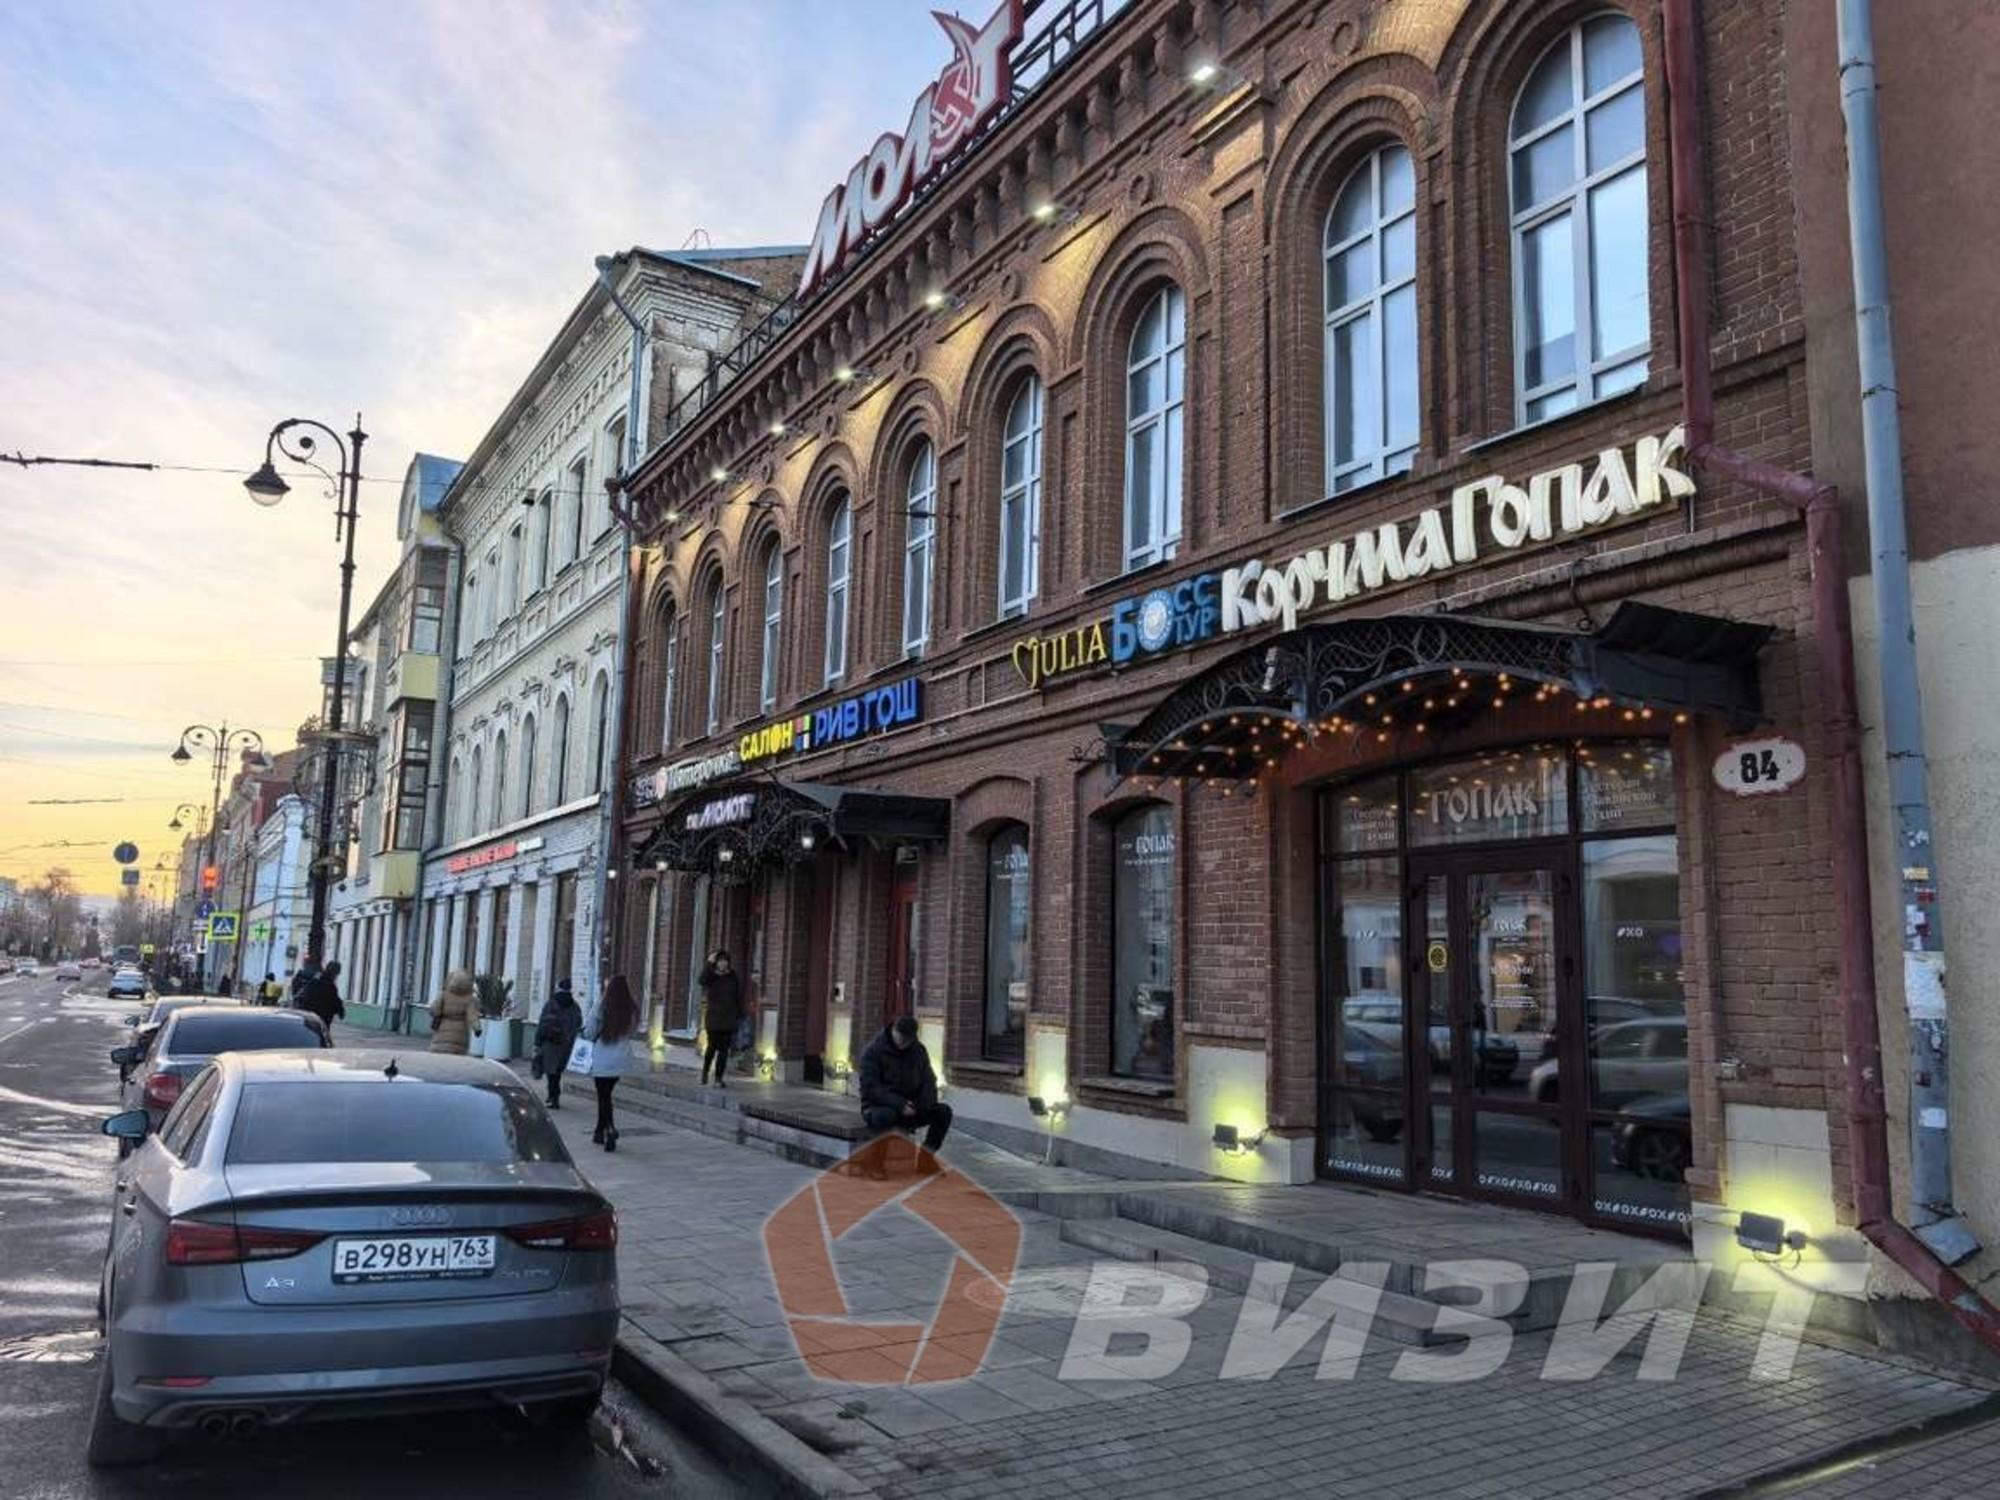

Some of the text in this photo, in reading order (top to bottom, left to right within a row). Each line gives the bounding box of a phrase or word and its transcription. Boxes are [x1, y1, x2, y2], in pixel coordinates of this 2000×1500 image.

[1173, 606, 1217, 646] ТУР
[814, 677, 918, 748] РИВ ГОШ
[739, 720, 793, 762] САЛОН
[1740, 750, 1780, 785] 84
[452, 1239, 489, 1259] 763
